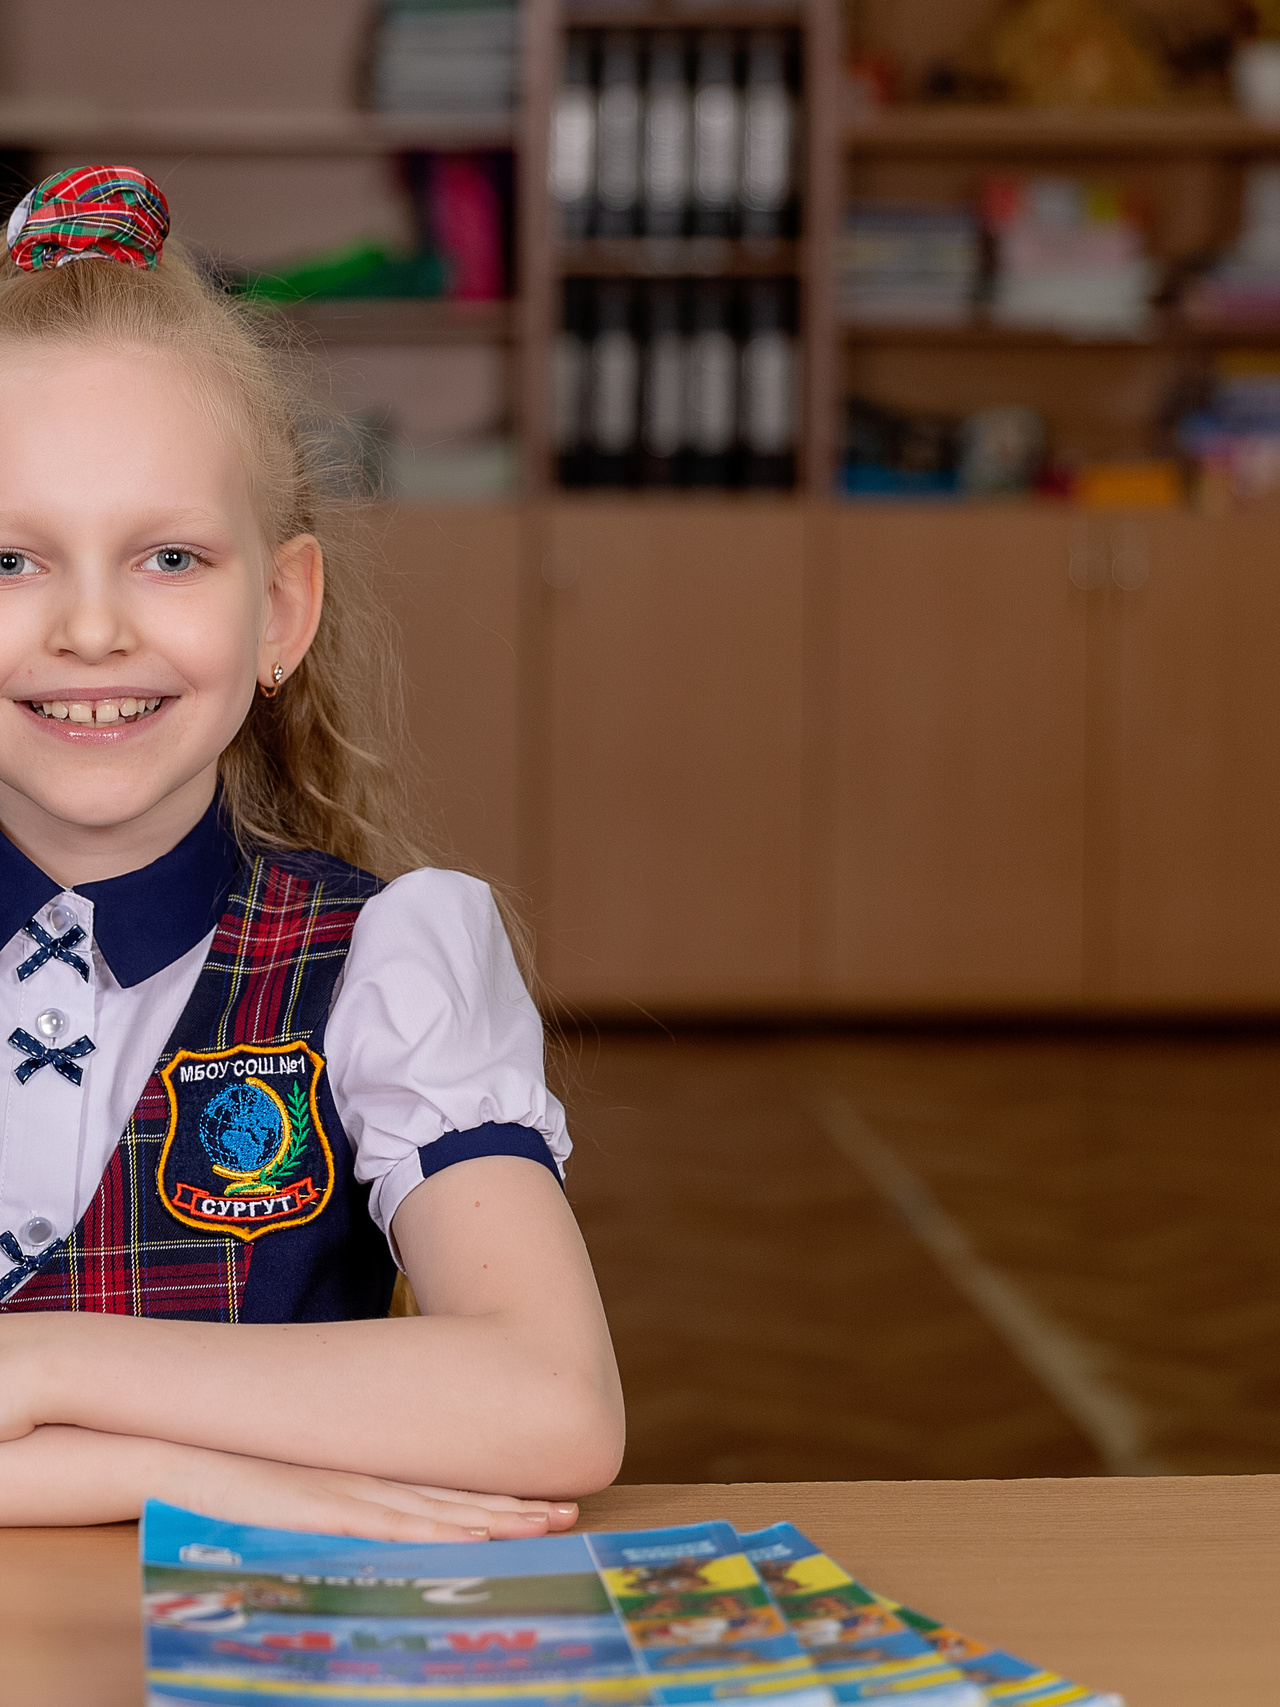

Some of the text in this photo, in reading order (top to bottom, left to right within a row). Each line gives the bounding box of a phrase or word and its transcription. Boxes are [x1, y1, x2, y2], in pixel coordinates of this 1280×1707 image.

[180, 1054, 306, 1082] МБОУ СОШ №1
[201, 1195, 292, 1217] СУРГУТ
